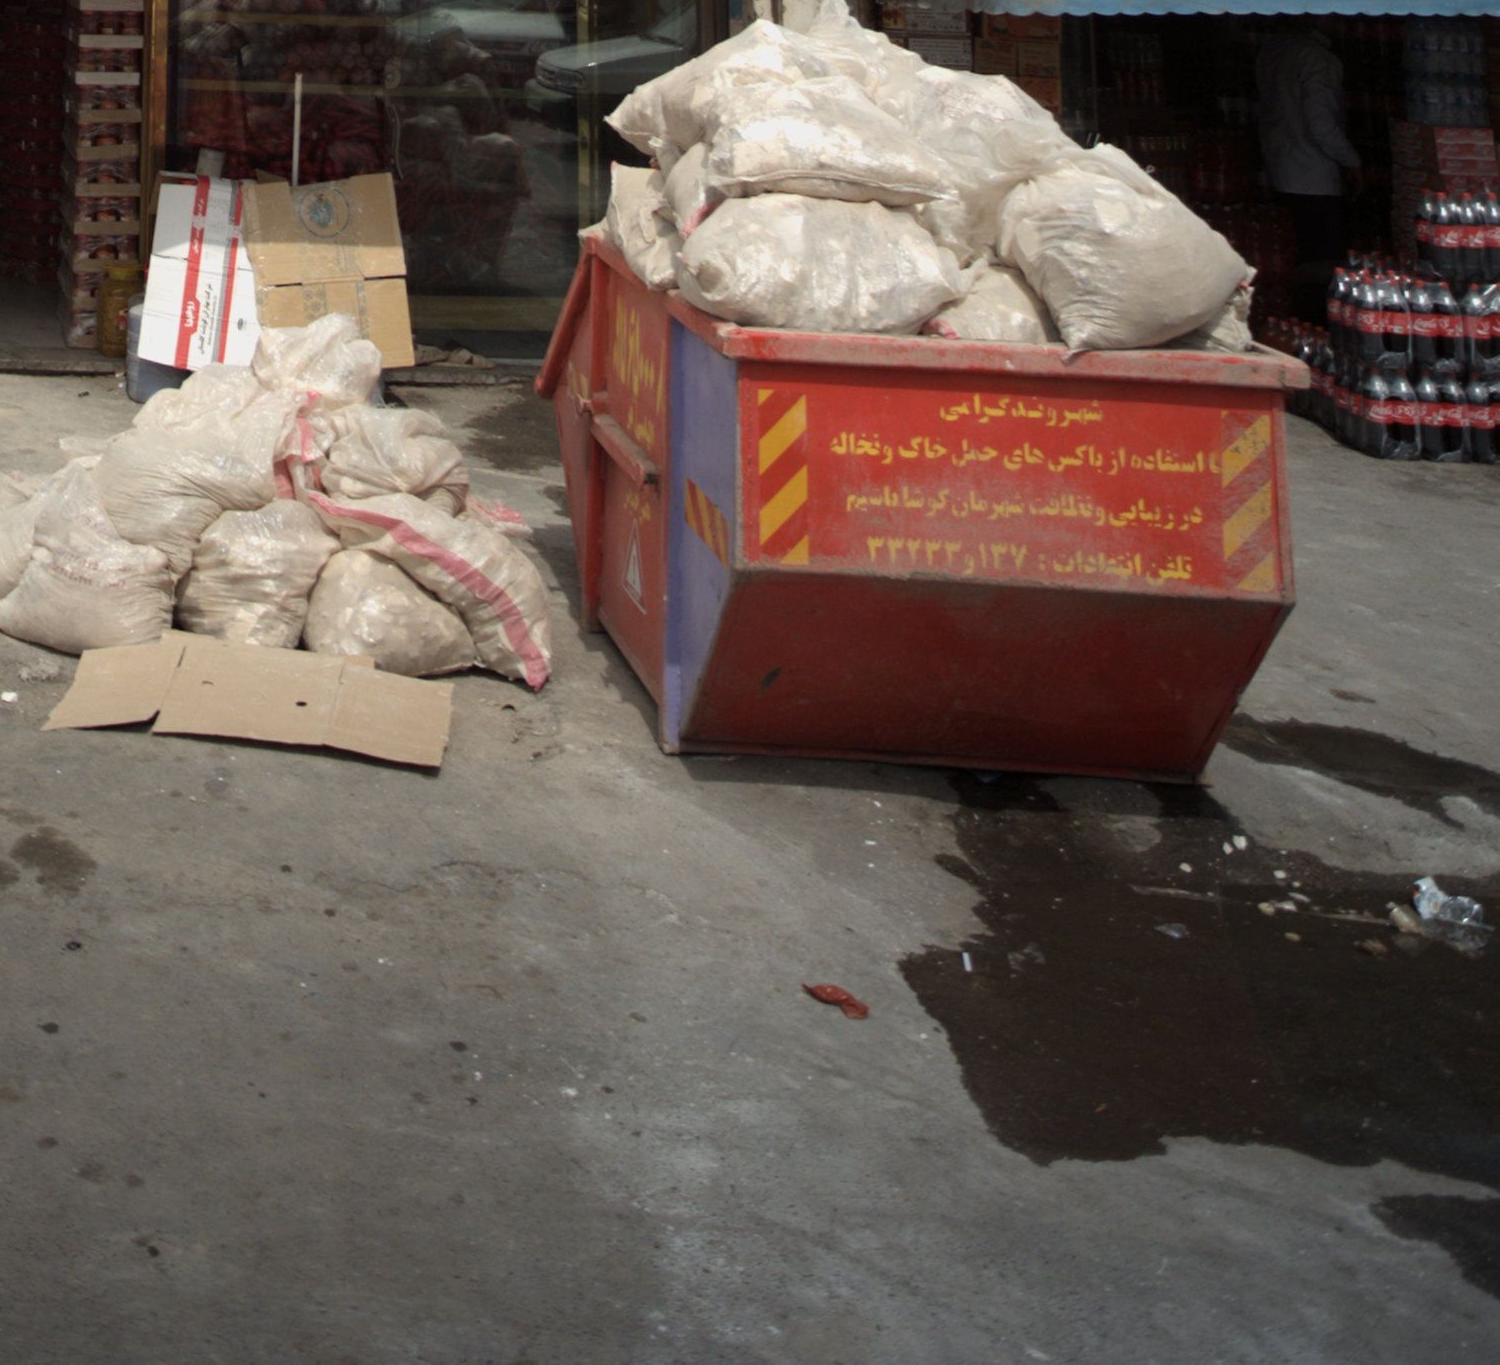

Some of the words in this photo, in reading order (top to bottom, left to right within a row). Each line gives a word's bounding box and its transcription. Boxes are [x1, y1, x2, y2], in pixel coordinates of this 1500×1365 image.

[898, 436, 948, 459] خاک
[951, 438, 999, 468] حمل
[1107, 446, 1126, 475] از
[1129, 448, 1204, 474] استفاده
[1178, 505, 1203, 531] در
[1145, 554, 1193, 586] تلفن
